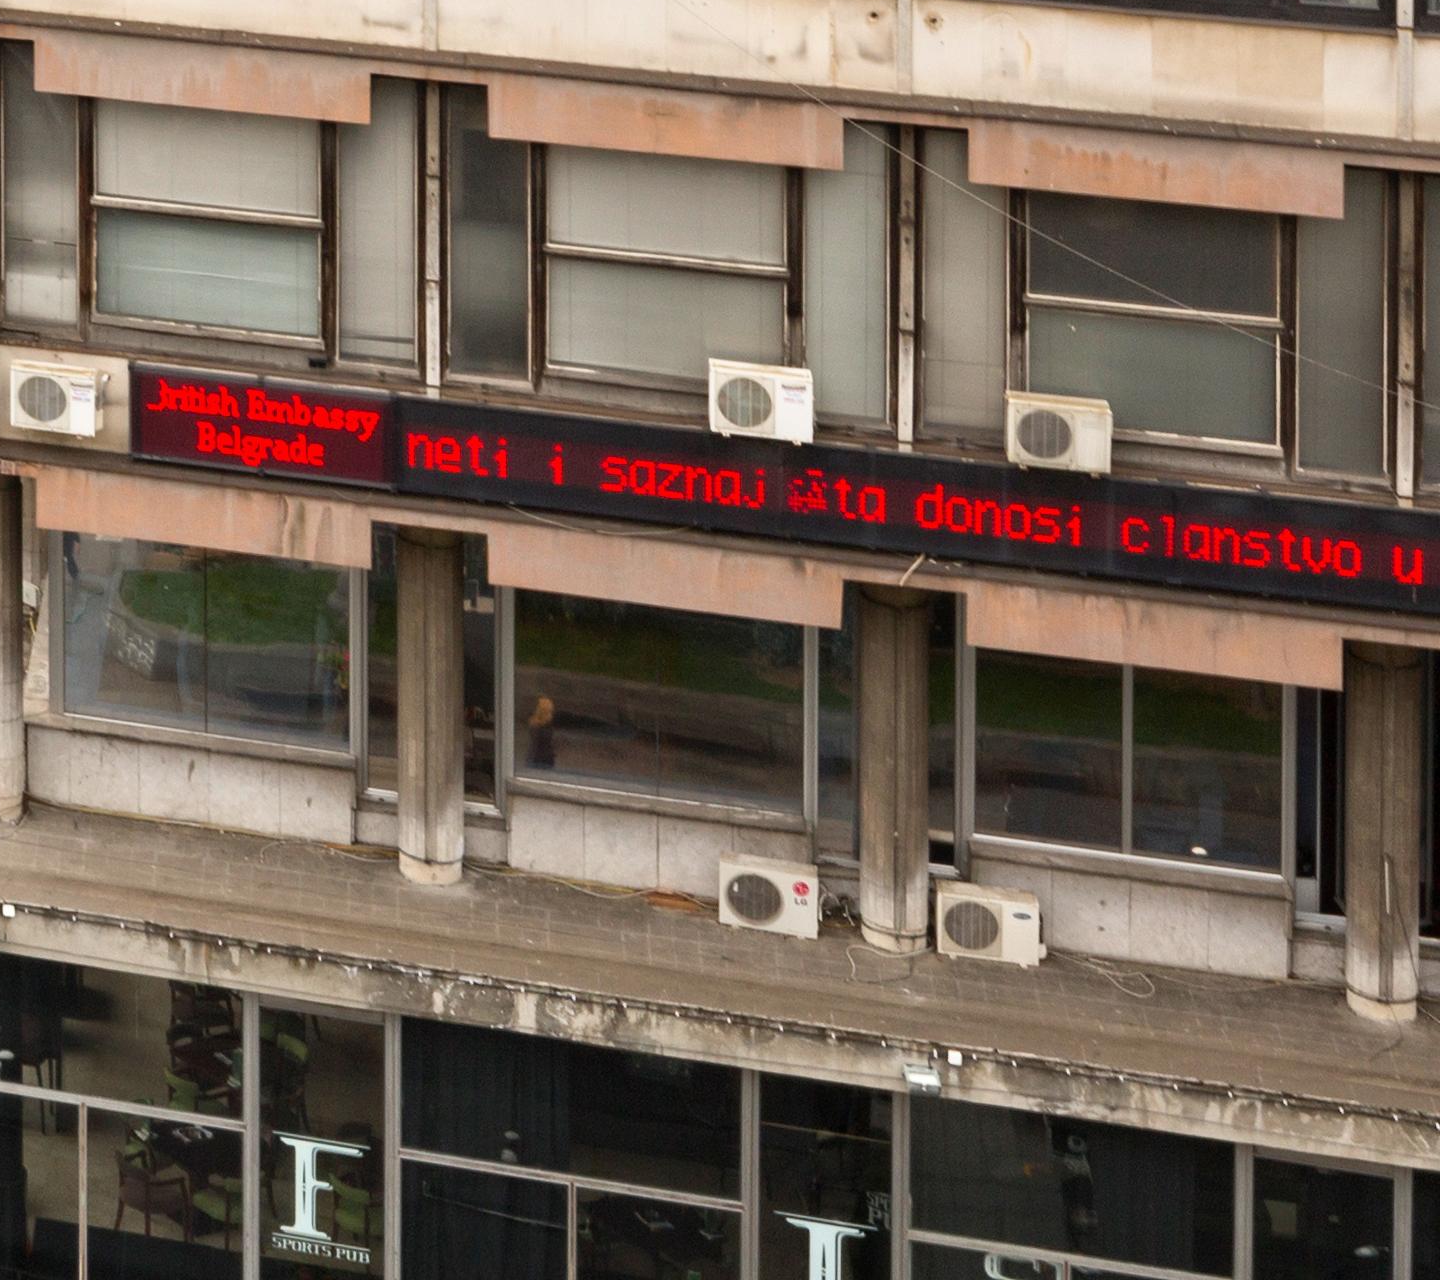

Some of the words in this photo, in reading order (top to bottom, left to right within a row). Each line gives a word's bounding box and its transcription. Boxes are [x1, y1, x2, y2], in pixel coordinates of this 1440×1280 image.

[247, 388, 380, 442] Embassy
[196, 420, 325, 468] Belgrade
[407, 432, 508, 478] neti
[548, 443, 563, 486] i
[599, 455, 765, 509] saznaj
[914, 483, 1080, 546] donosi
[1121, 514, 1362, 578] clanstvo
[1392, 544, 1425, 585] u
[272, 1236, 333, 1258] SPORTS
[336, 1247, 371, 1264] PUB
